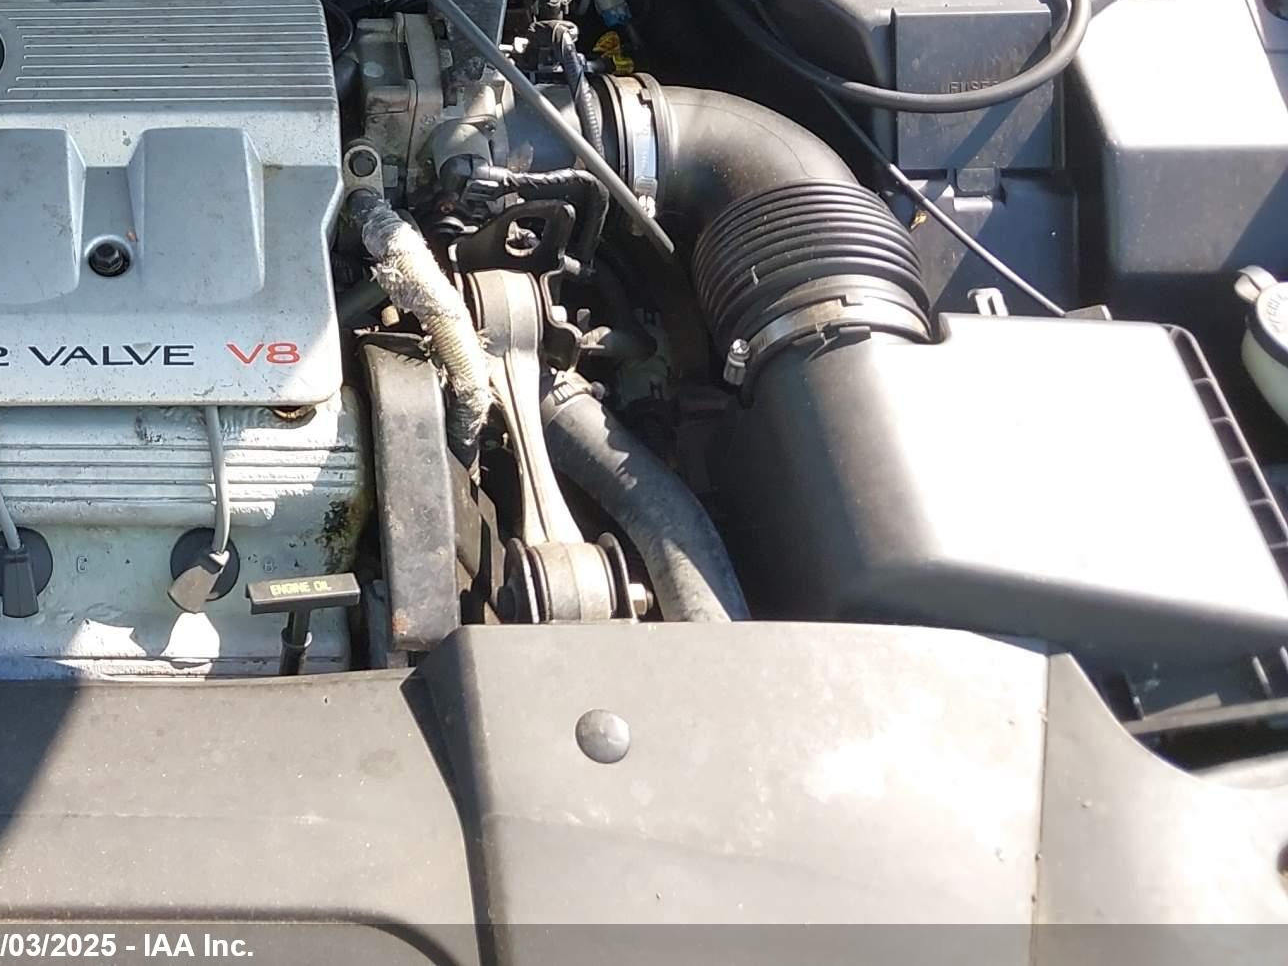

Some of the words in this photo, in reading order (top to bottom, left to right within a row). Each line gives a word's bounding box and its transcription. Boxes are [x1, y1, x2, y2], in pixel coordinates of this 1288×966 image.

[28, 344, 195, 366] VALVE
[225, 342, 302, 365] V8
[269, 581, 312, 596] ENGINE
[313, 580, 332, 591] OIL
